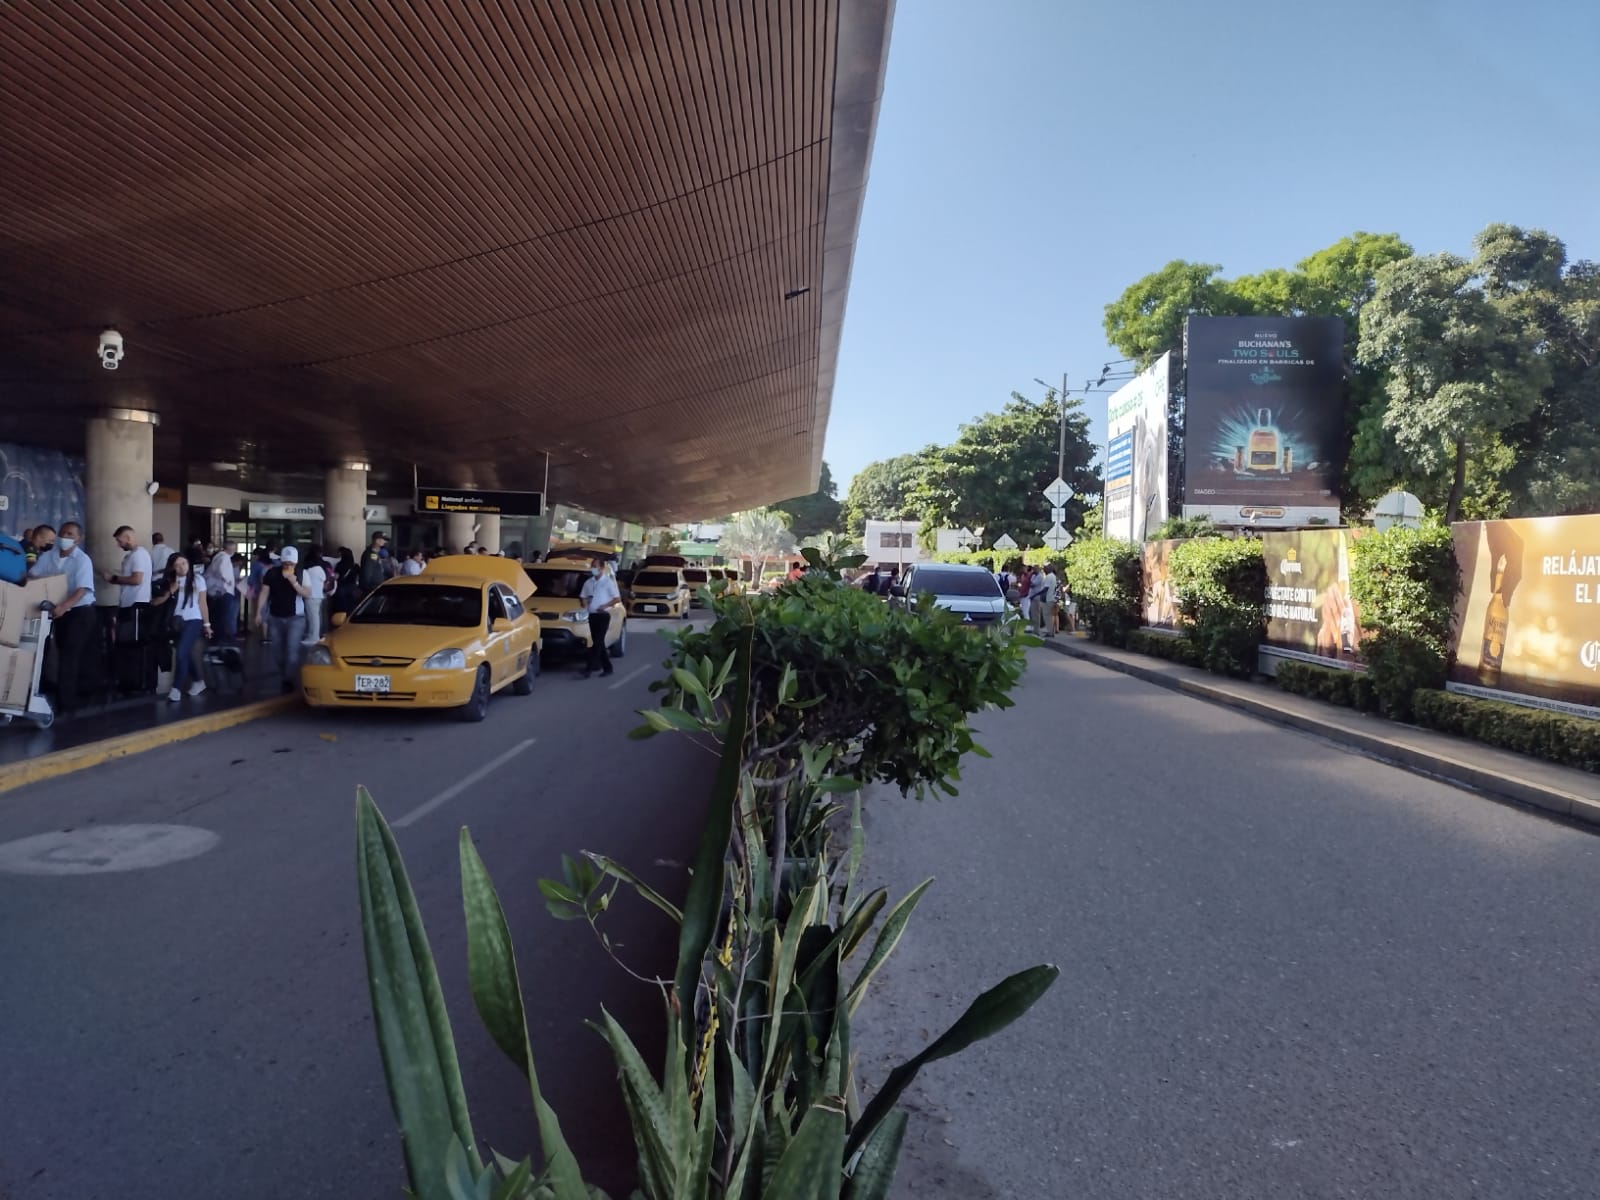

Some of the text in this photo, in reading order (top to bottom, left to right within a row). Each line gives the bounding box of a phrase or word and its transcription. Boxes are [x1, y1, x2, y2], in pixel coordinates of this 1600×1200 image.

[1232, 349, 1257, 357] TWO
[1295, 588, 1306, 602] CON
[1308, 588, 1316, 603] TU
[1576, 583, 1592, 603] EL
